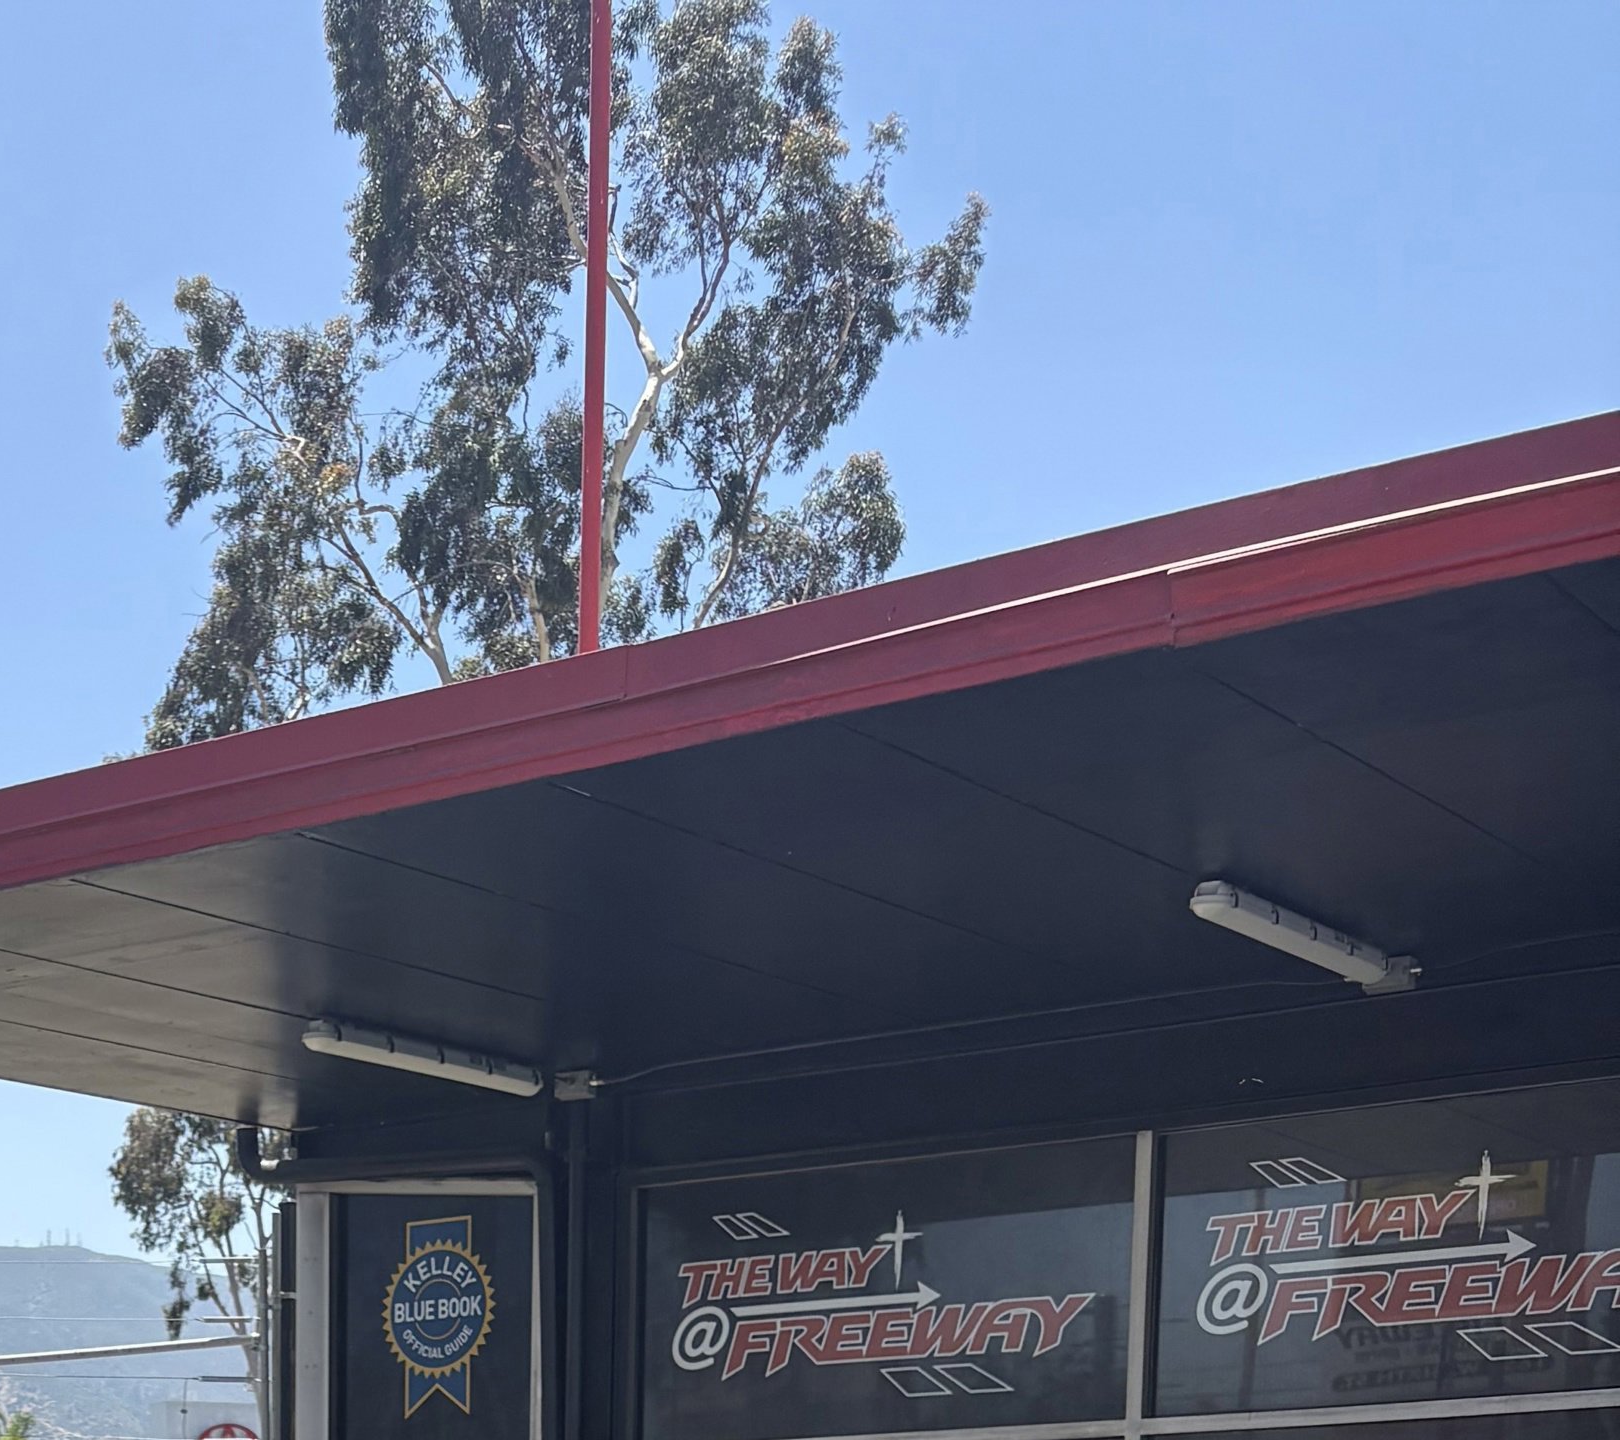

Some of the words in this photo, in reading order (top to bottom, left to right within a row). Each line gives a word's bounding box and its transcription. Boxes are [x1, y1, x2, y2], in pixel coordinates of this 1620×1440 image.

[403, 1256, 477, 1293] KELLEY
[394, 1300, 435, 1323] BLUE
[438, 1295, 482, 1319] BOOK
[402, 1329, 445, 1358] OFFICIAL
[444, 1324, 474, 1356] GUIDE
